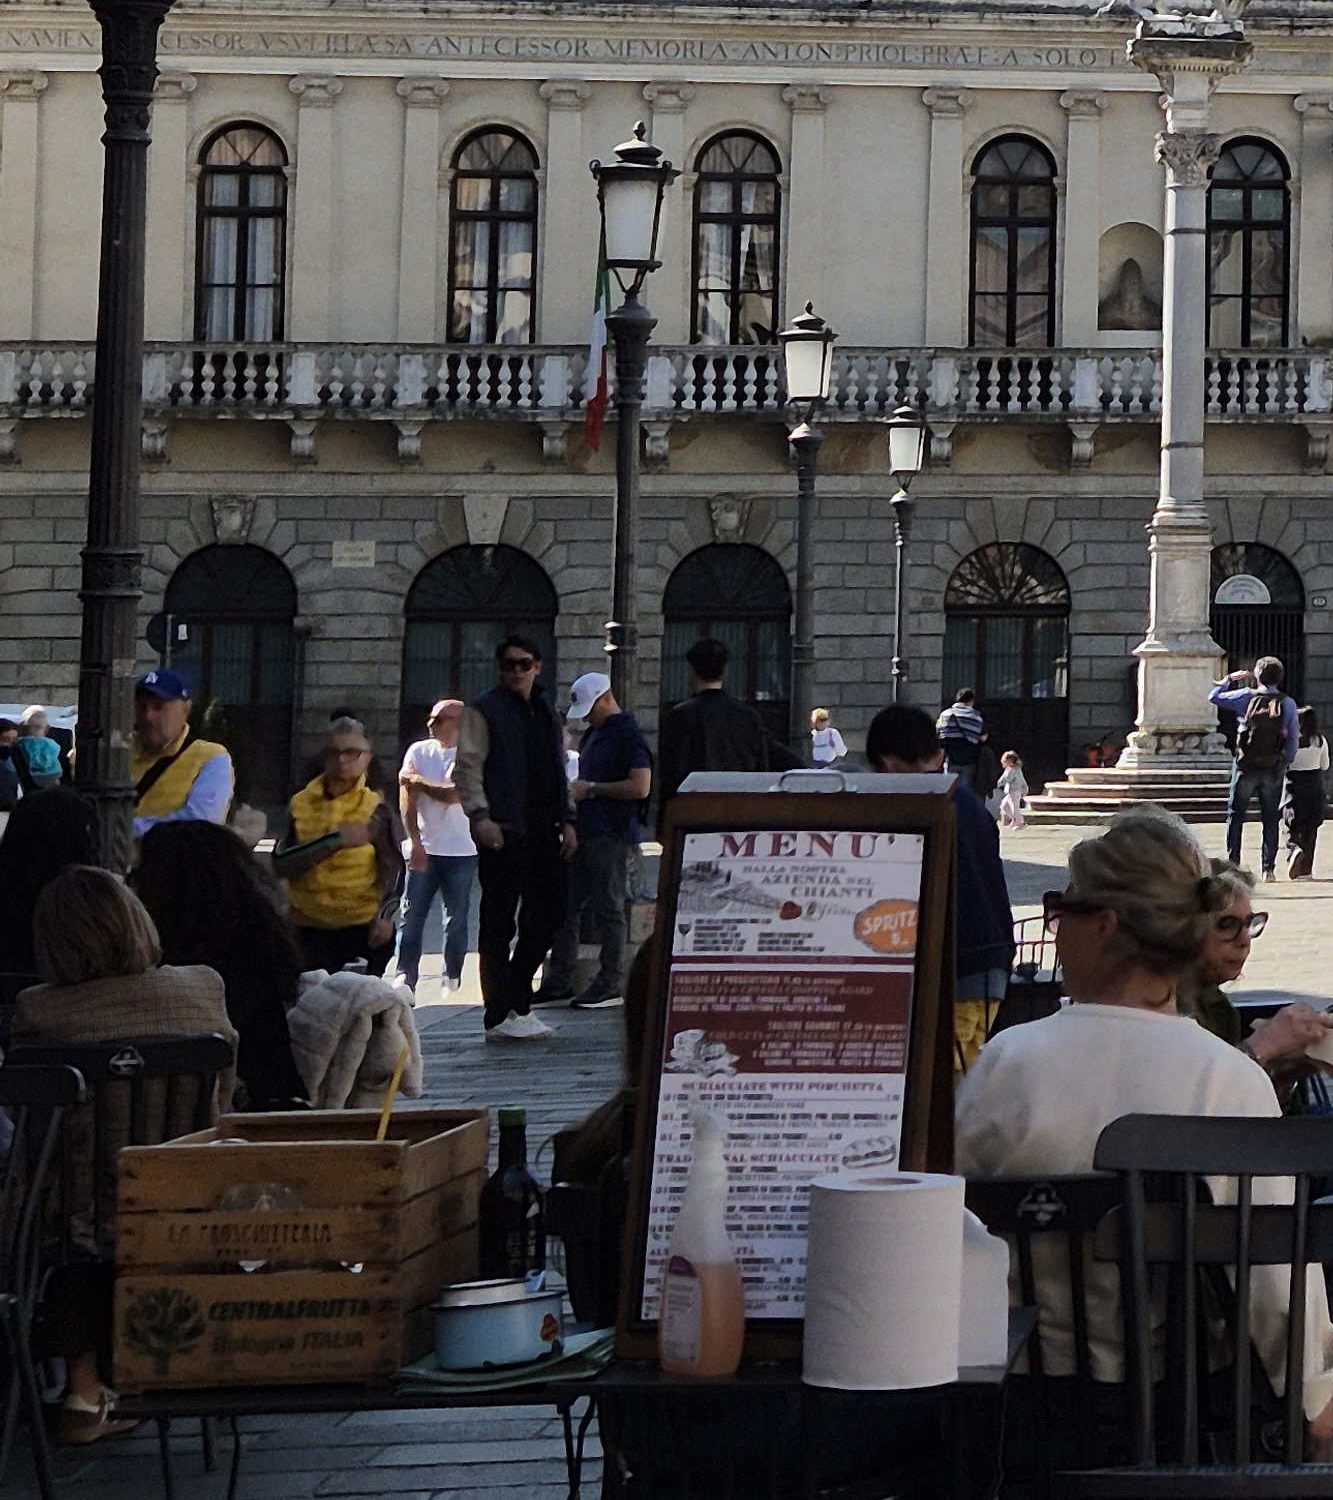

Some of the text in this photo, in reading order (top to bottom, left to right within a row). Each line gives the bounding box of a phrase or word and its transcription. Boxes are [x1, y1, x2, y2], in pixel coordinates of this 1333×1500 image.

[426, 36, 590, 57] ANTECESSOR
[604, 40, 728, 58] MEMORIA
[1033, 49, 1097, 67] SOLO
[790, 887, 874, 898] CHIANTI
[861, 909, 917, 935] SPRITZ
